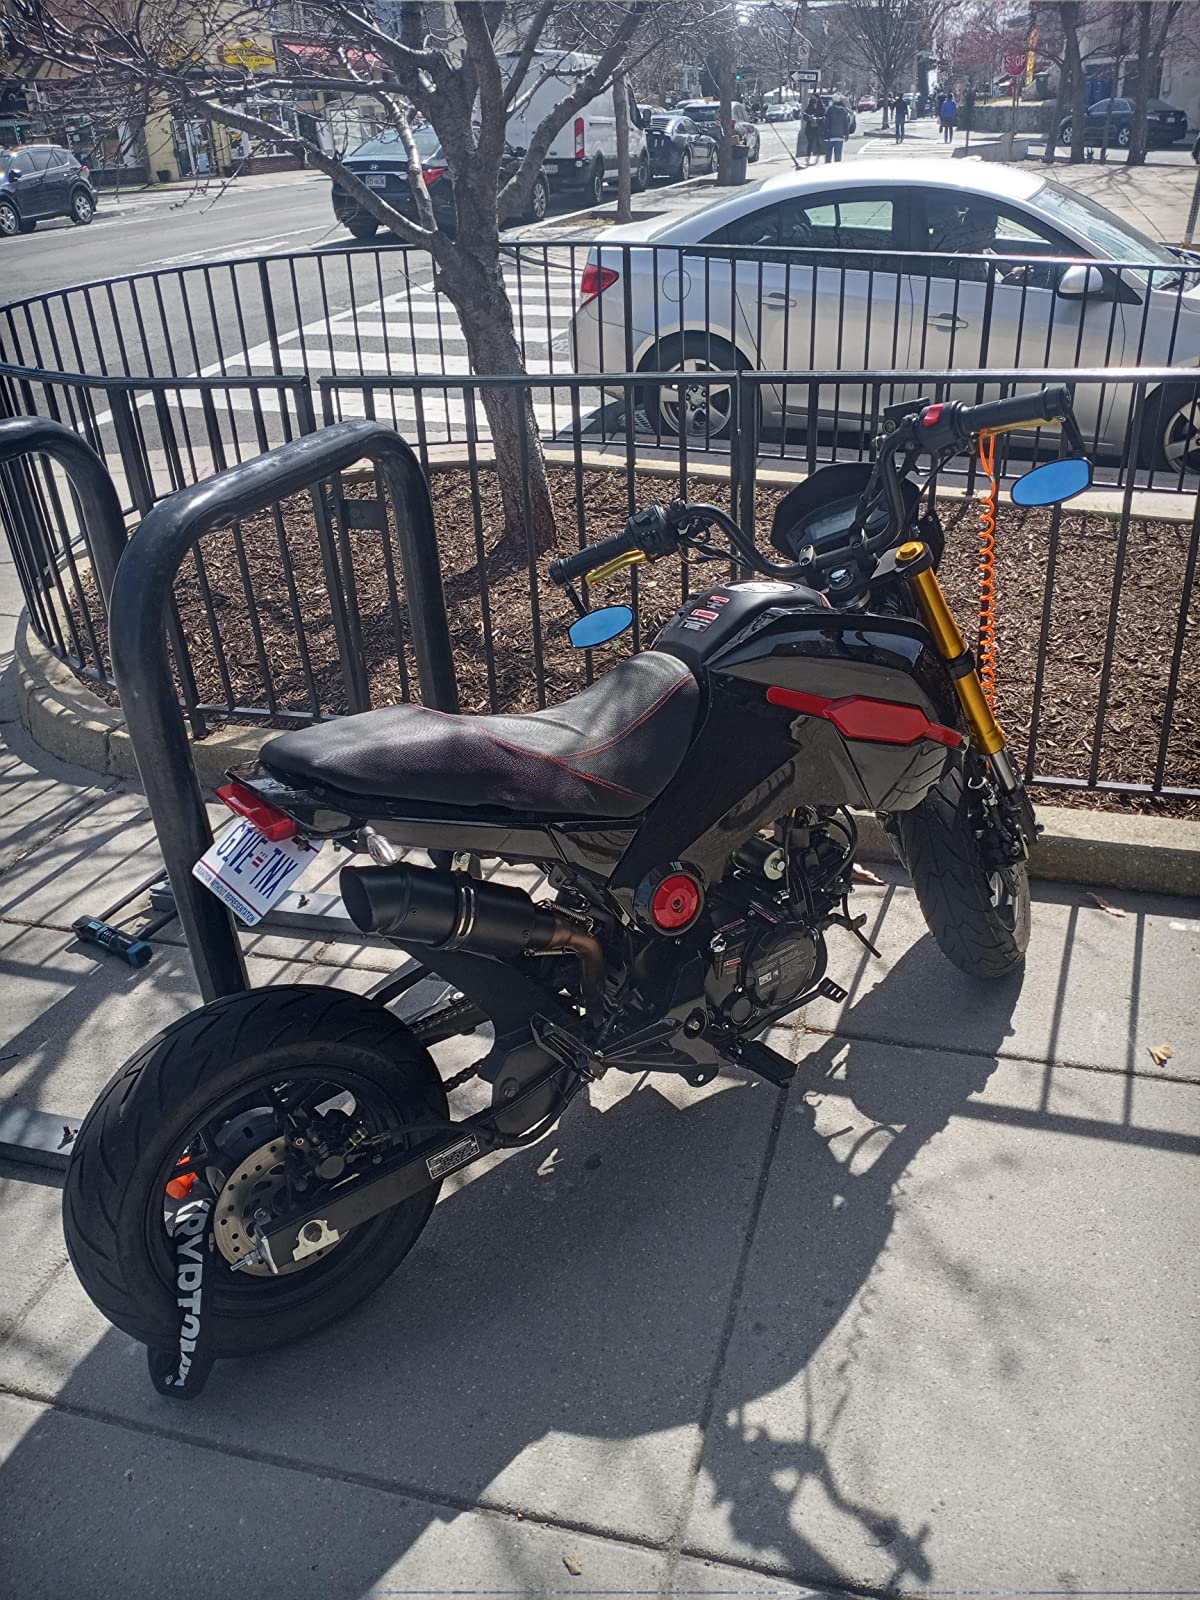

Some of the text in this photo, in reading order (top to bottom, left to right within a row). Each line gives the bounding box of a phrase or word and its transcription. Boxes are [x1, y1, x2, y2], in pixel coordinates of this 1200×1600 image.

[1005, 54, 1026, 67] STOP
[217, 820, 298, 899] GIVE TNX
[210, 880, 227, 896] WITHOUT
[224, 892, 256, 923] REPRESENTATION
